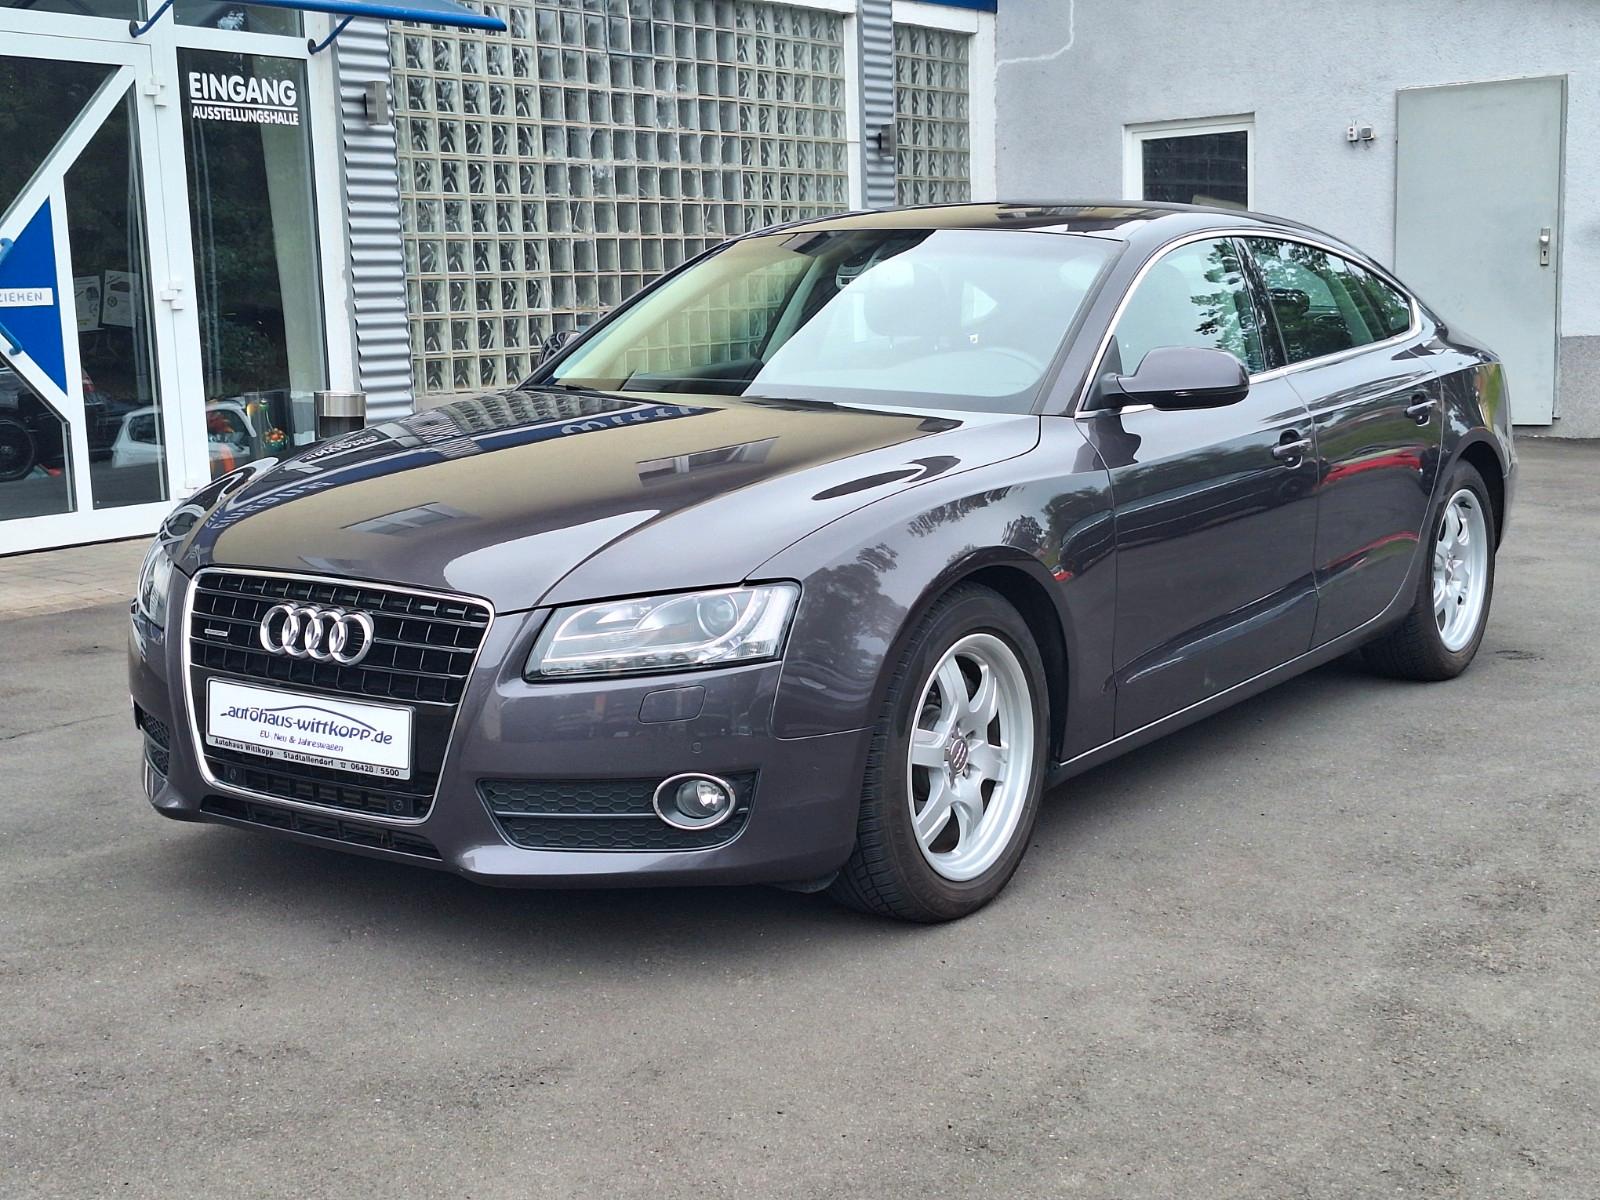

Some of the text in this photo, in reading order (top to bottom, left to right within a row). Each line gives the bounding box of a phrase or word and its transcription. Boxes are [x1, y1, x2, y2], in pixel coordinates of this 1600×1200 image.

[188, 71, 297, 106] EINGANG
[192, 105, 299, 126] AUSSTELLUNGSHALLE
[214, 738, 244, 750] Autohaus
[245, 744, 274, 756] Wittkopp
[283, 751, 334, 766] Stadtallendorf
[350, 762, 374, 773] 06428
[380, 767, 400, 777] 5500
